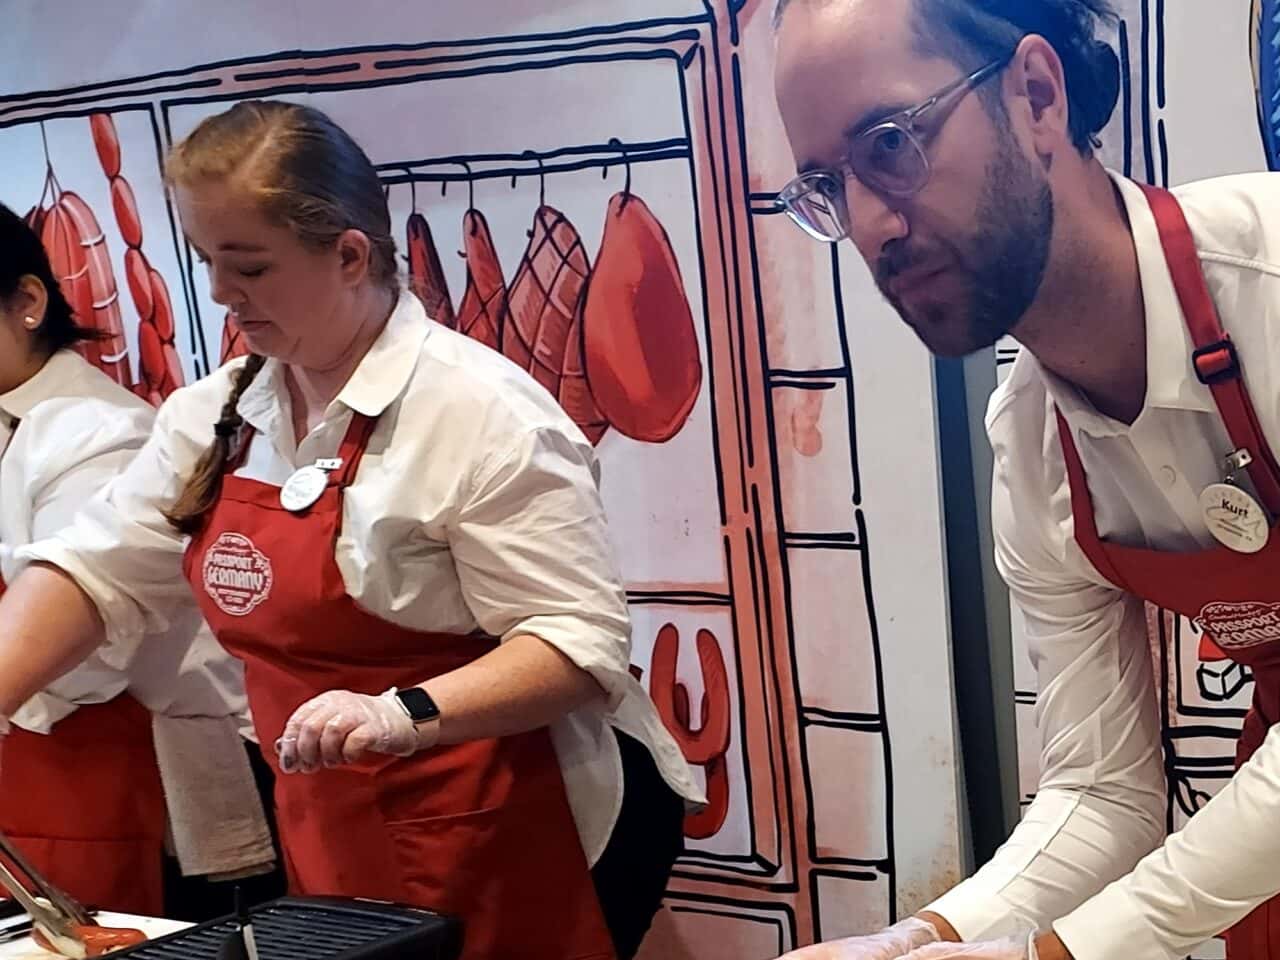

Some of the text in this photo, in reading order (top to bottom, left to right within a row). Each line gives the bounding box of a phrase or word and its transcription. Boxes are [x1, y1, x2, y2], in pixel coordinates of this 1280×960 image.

[1221, 498, 1249, 518] Kurt
[207, 566, 263, 591] GERMANY
[1210, 611, 1280, 633] PASSPORT
